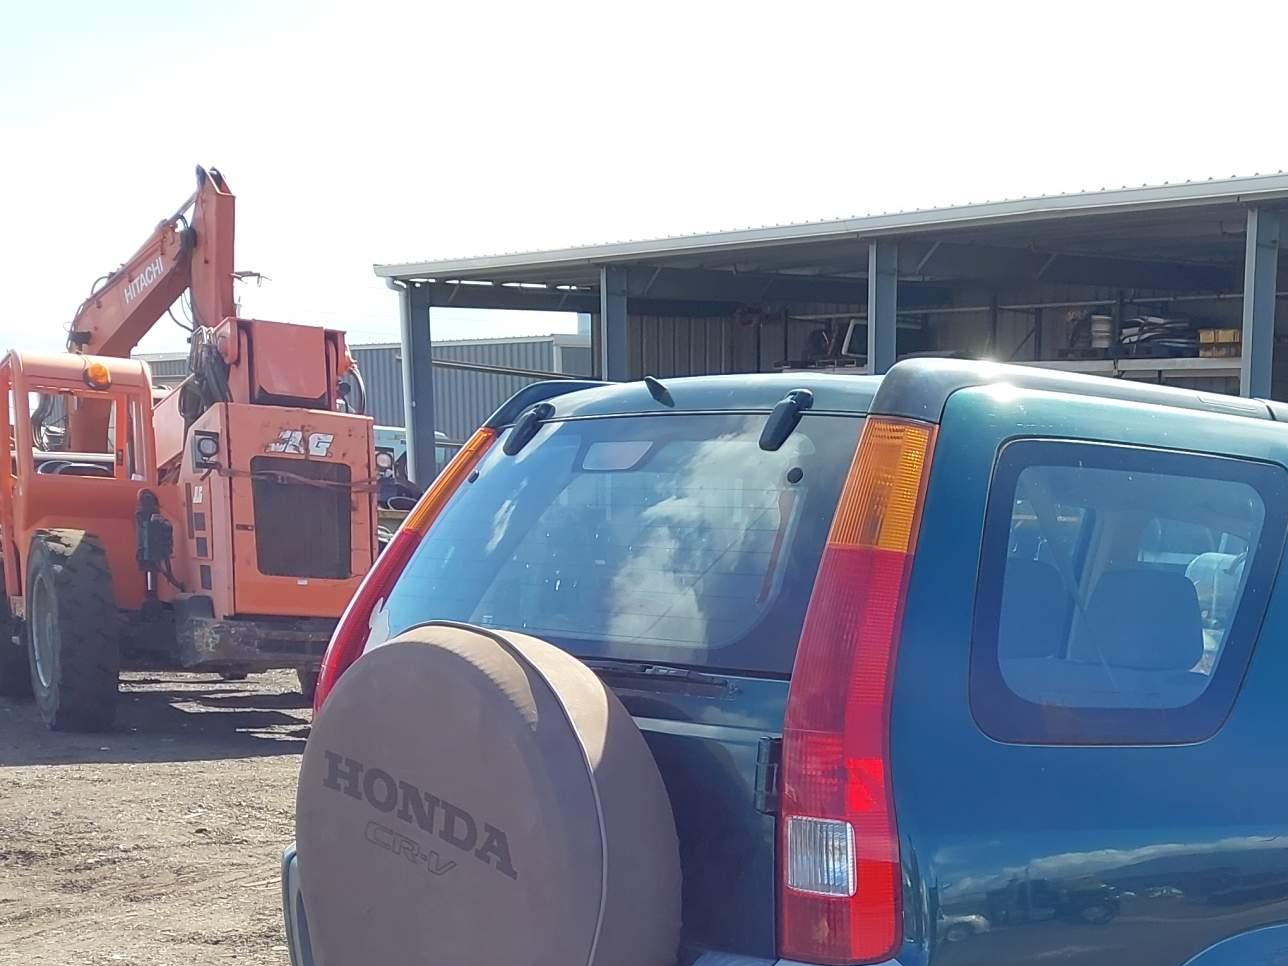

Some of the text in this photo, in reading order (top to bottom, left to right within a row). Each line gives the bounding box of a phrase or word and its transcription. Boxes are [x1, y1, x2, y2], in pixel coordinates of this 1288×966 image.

[123, 256, 164, 305] HITACHI
[323, 750, 518, 881] HONDA
[364, 820, 457, 877] CR-V
